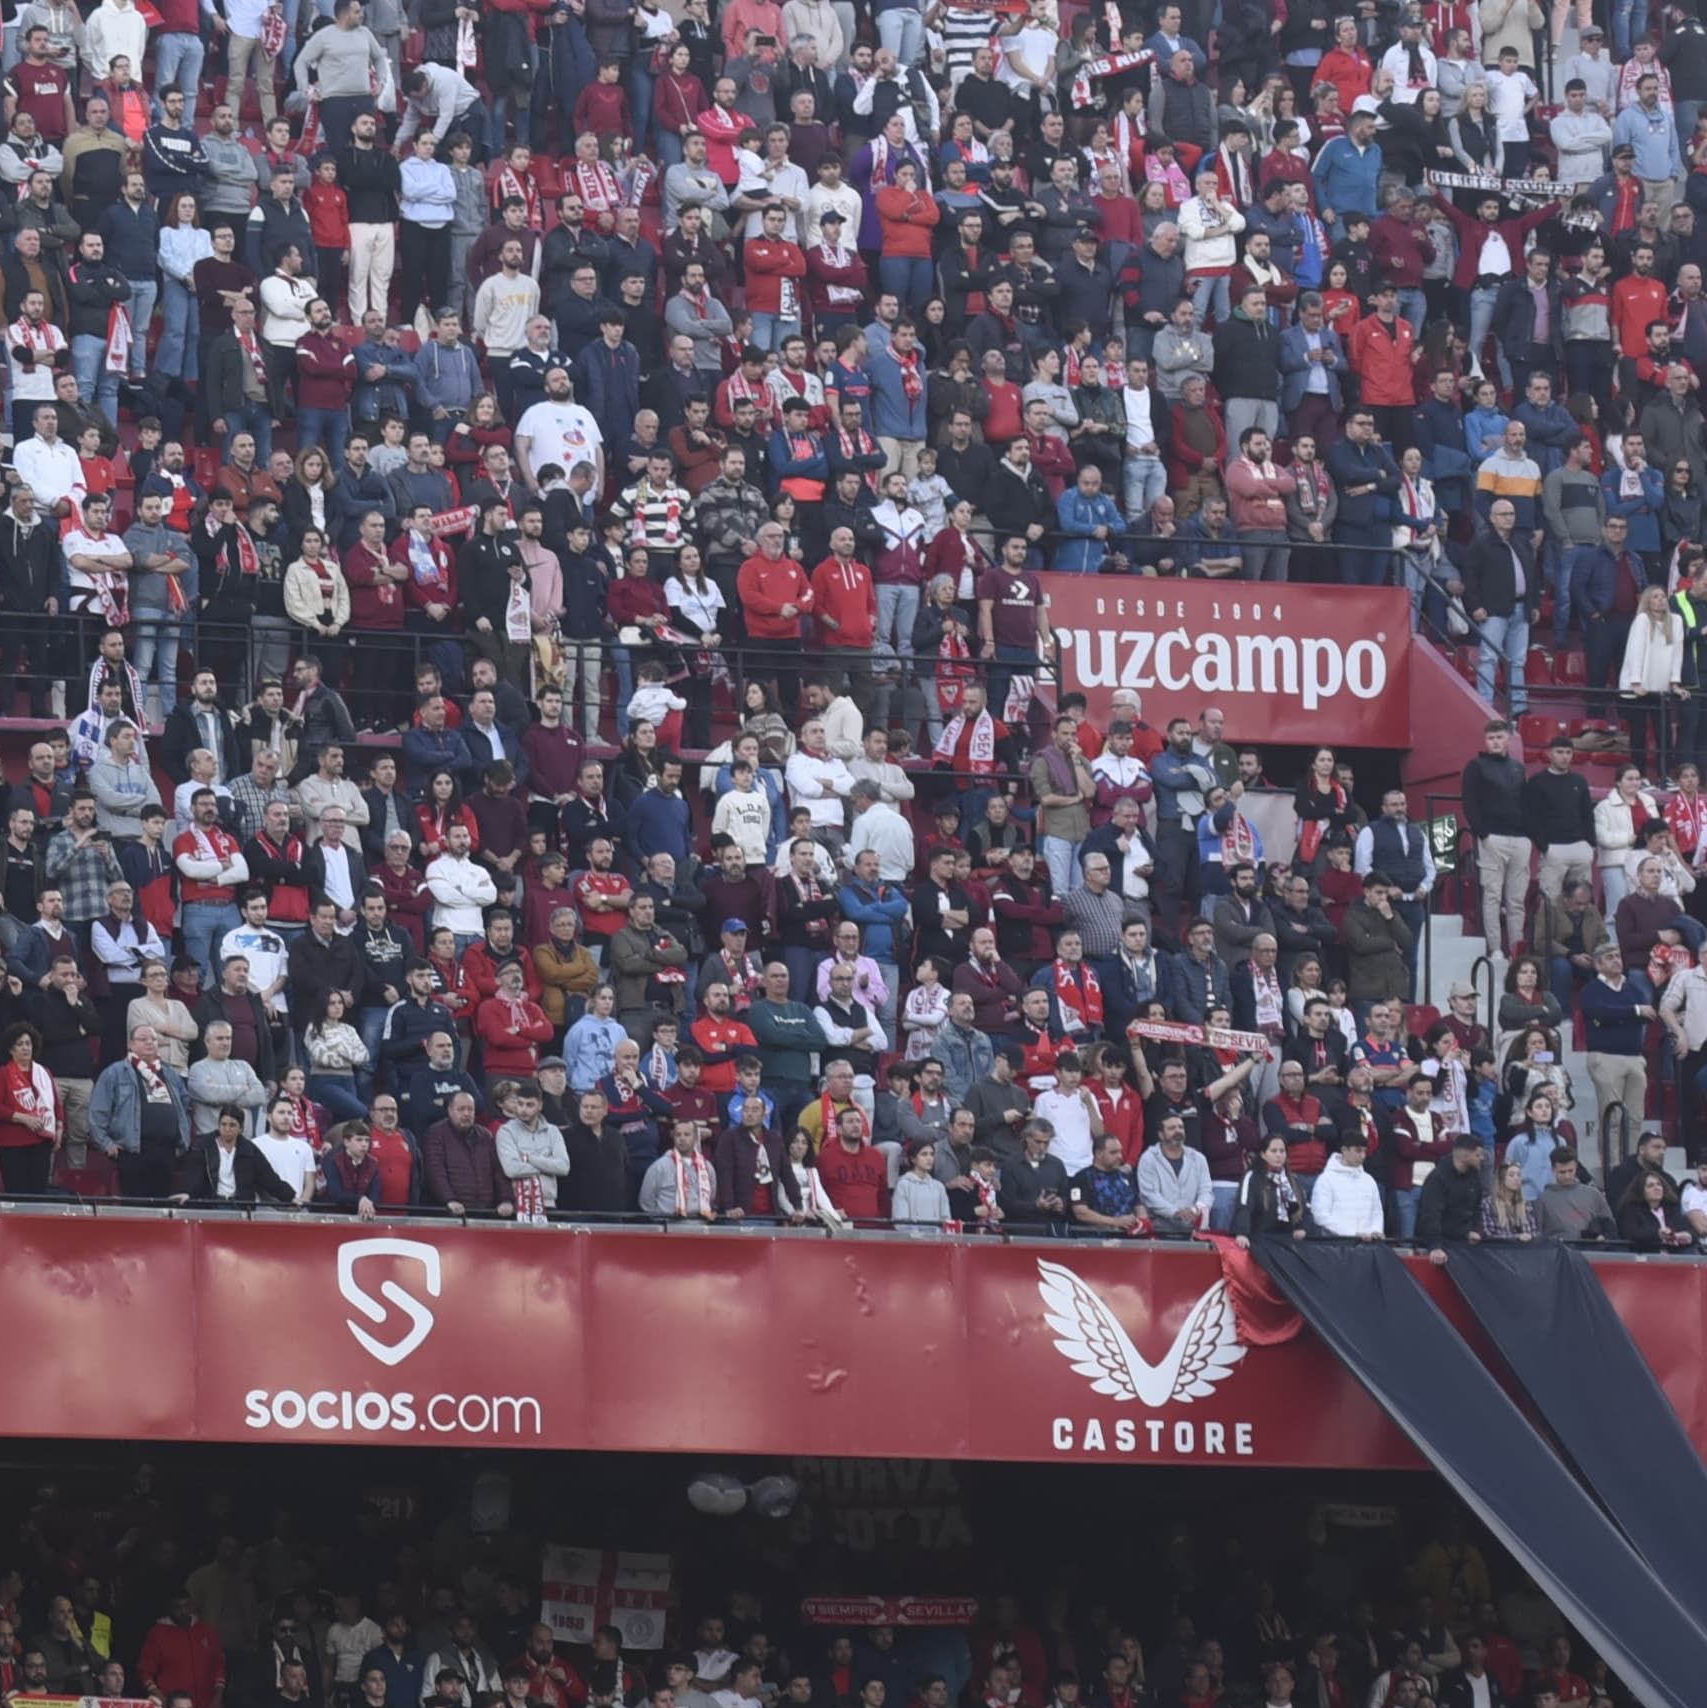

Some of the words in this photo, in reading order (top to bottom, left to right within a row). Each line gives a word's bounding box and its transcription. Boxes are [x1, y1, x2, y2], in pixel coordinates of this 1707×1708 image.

[1096, 597, 1186, 618] DESDE
[1212, 603, 1283, 621] 1904
[1037, 625, 1387, 711] ruzcampo
[245, 1389, 542, 1436] SOCIOS.com
[1052, 1416, 1254, 1457] CASTORE
[818, 1604, 877, 1617] SIEMPRE
[906, 1604, 965, 1617] SEVILLA
